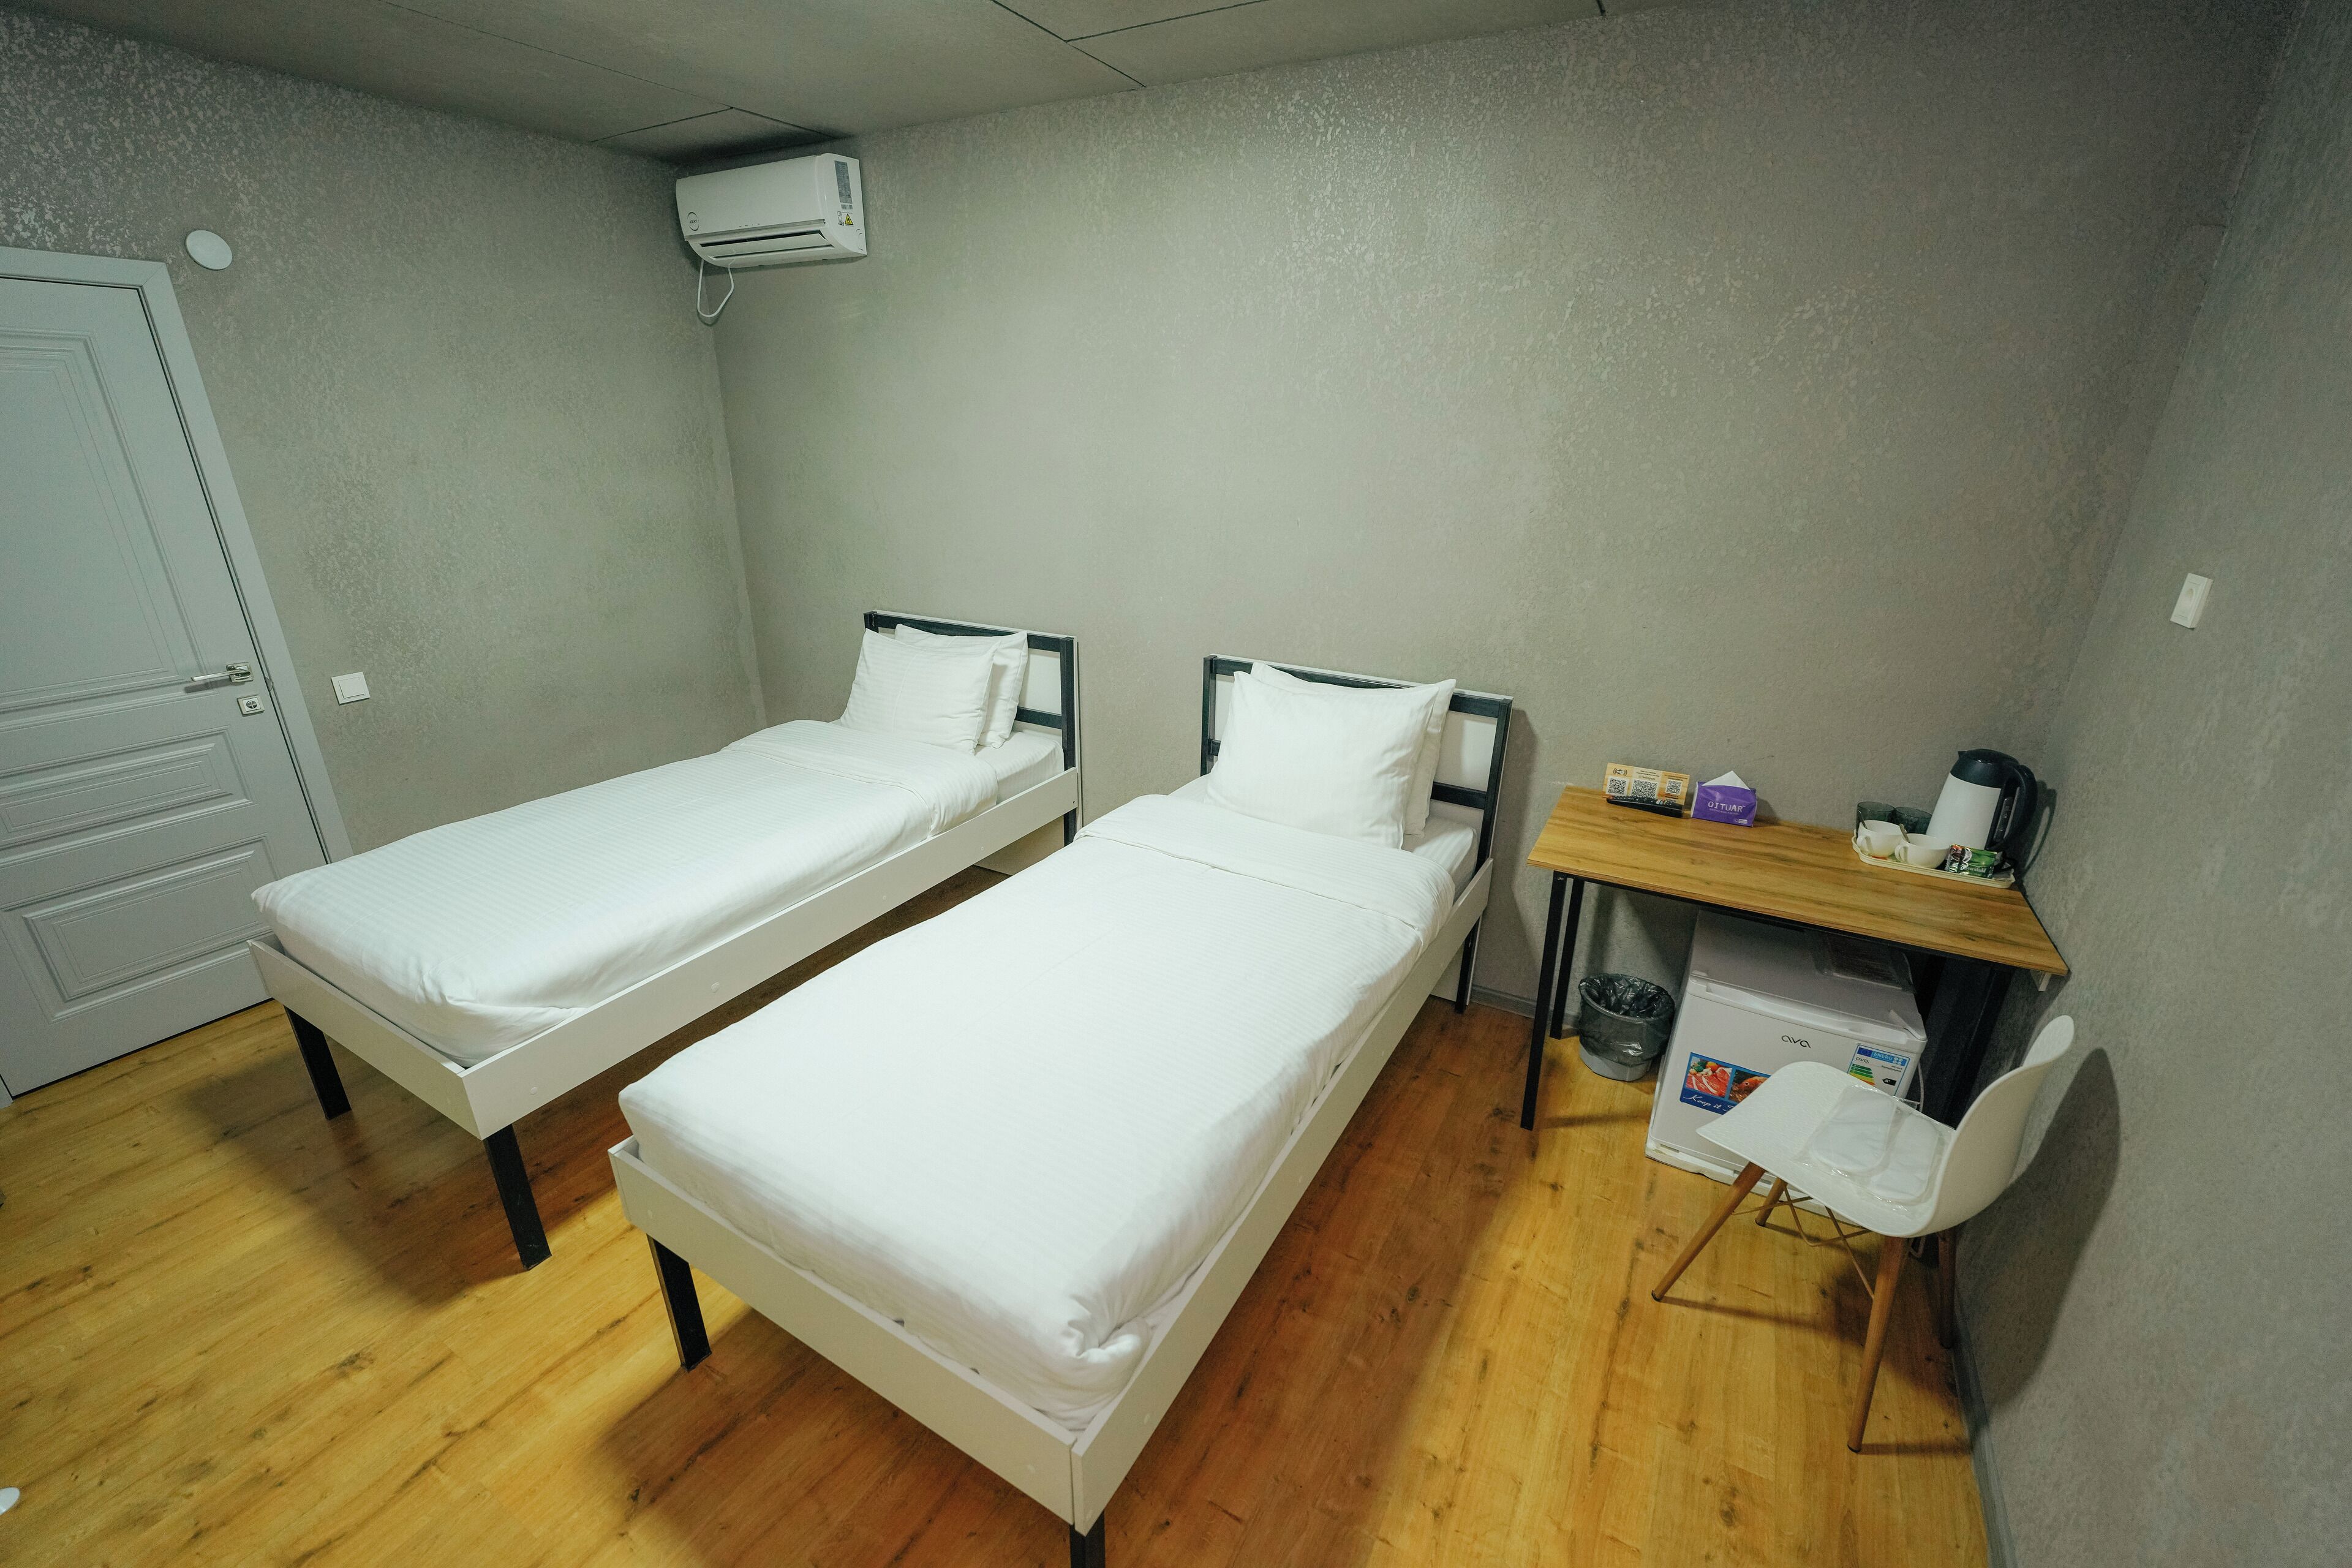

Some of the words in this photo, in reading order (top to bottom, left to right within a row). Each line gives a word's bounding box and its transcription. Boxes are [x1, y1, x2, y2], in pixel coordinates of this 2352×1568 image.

[1708, 801, 1743, 813] OITUAR
[1781, 1035, 1811, 1049] ava
[1873, 1052, 1893, 1060] ENERG
[1683, 1095, 1711, 1106] Keep
